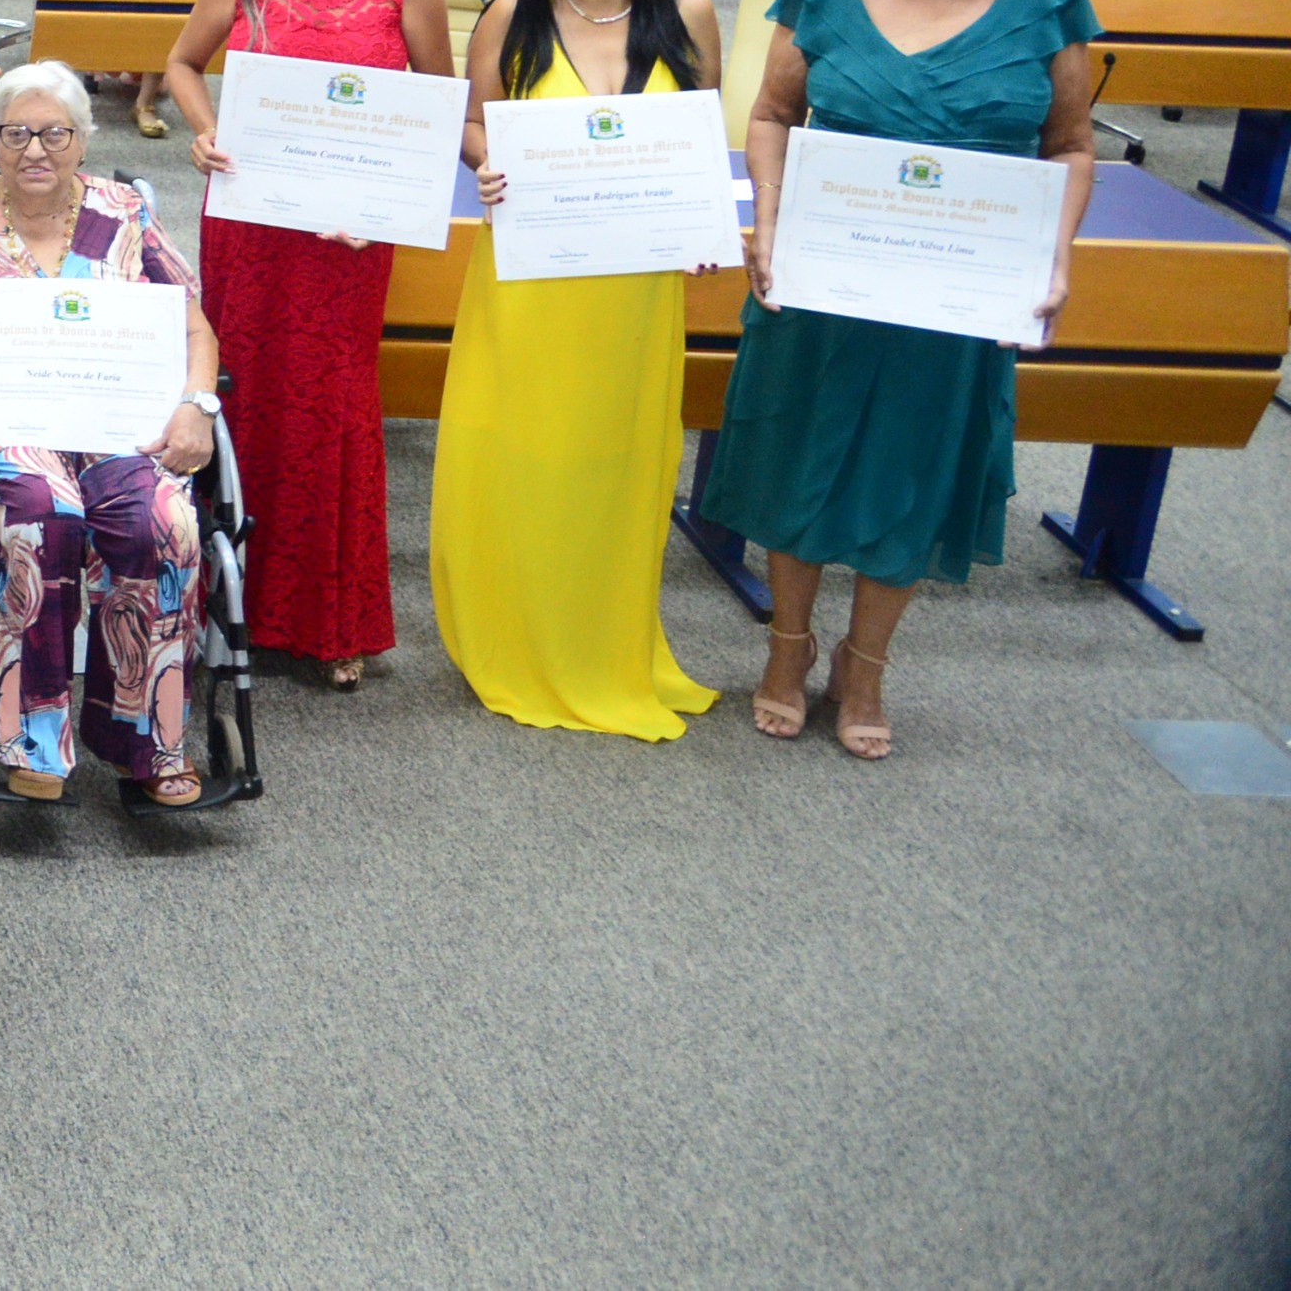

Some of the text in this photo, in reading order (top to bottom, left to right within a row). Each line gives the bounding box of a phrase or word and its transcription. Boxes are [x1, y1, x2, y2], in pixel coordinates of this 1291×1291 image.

[282, 145, 392, 167] Juliana Correia Tavares
[821, 181, 1019, 215] Diploma de Honra ao Mérito
[851, 231, 976, 256] Maria Isabel Silva Lima
[27, 369, 121, 382] Neide Neves de Faria
